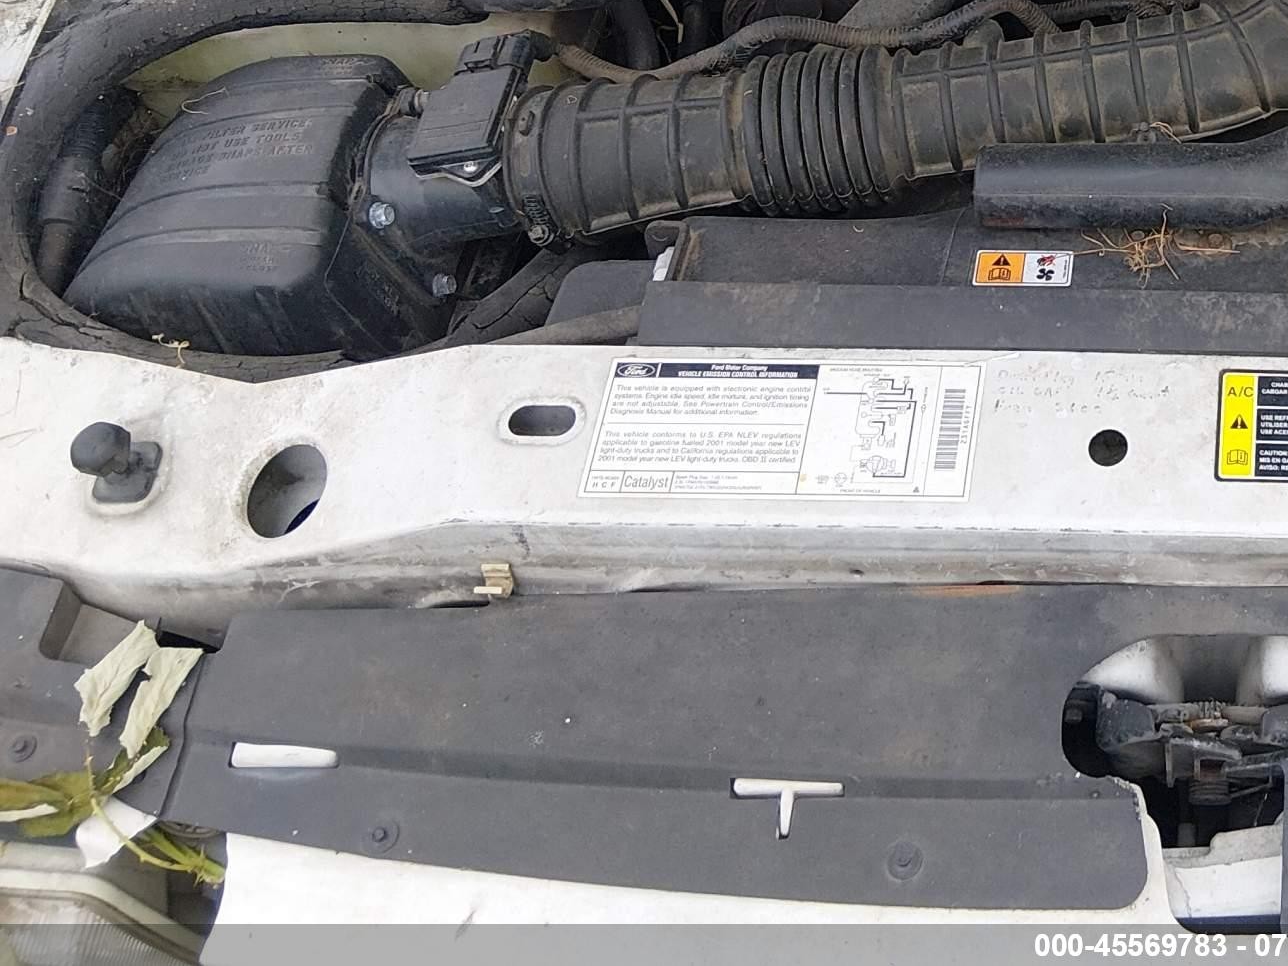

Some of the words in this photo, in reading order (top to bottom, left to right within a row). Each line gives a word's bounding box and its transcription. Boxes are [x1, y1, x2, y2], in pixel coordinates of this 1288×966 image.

[255, 132, 300, 144] TOOLS
[1227, 386, 1254, 398] A/C
[624, 475, 668, 490] Catalyst
